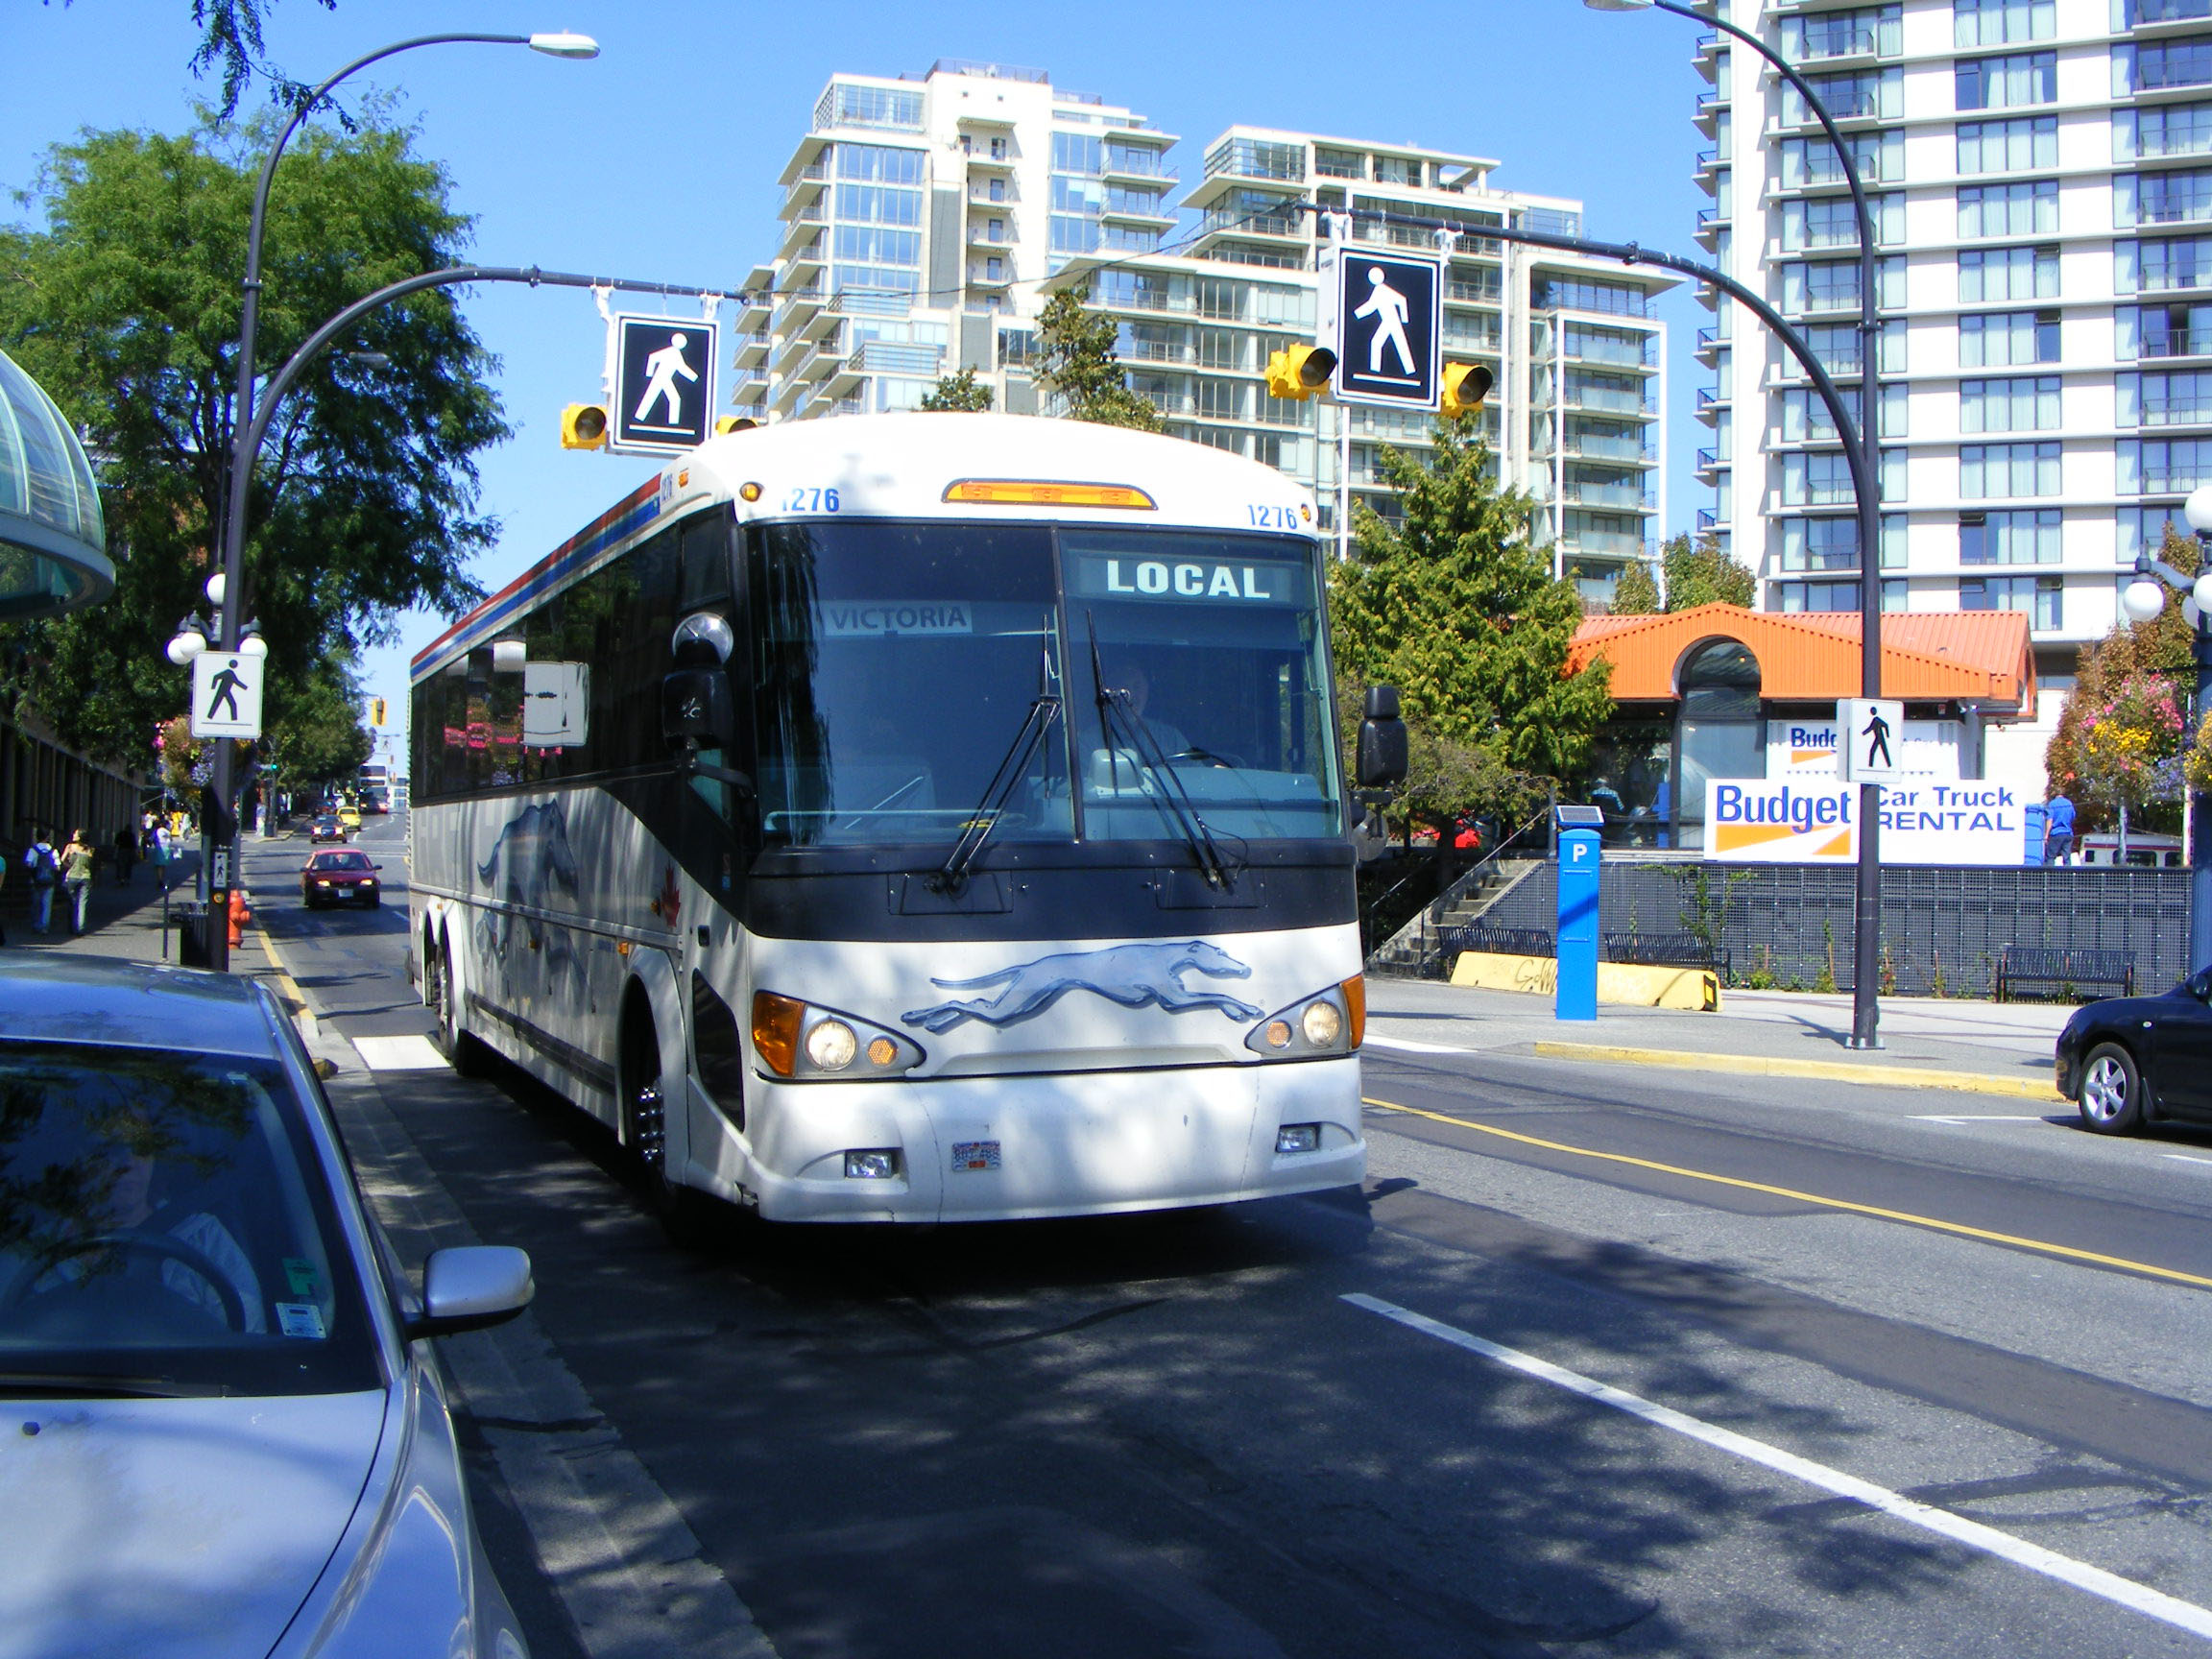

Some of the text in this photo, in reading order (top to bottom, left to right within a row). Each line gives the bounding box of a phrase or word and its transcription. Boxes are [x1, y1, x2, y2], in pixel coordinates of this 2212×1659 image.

[782, 488, 839, 513] 1276
[1247, 504, 1297, 530] 1276
[1107, 560, 1270, 599] LOCAL
[830, 607, 967, 630] VICTORIA
[1791, 728, 1837, 753] Bud
[1933, 786, 2014, 806] Truck
[1717, 785, 1852, 833] Budget
[1879, 812, 2014, 830] RENTAL
[1573, 843, 1588, 863] P
